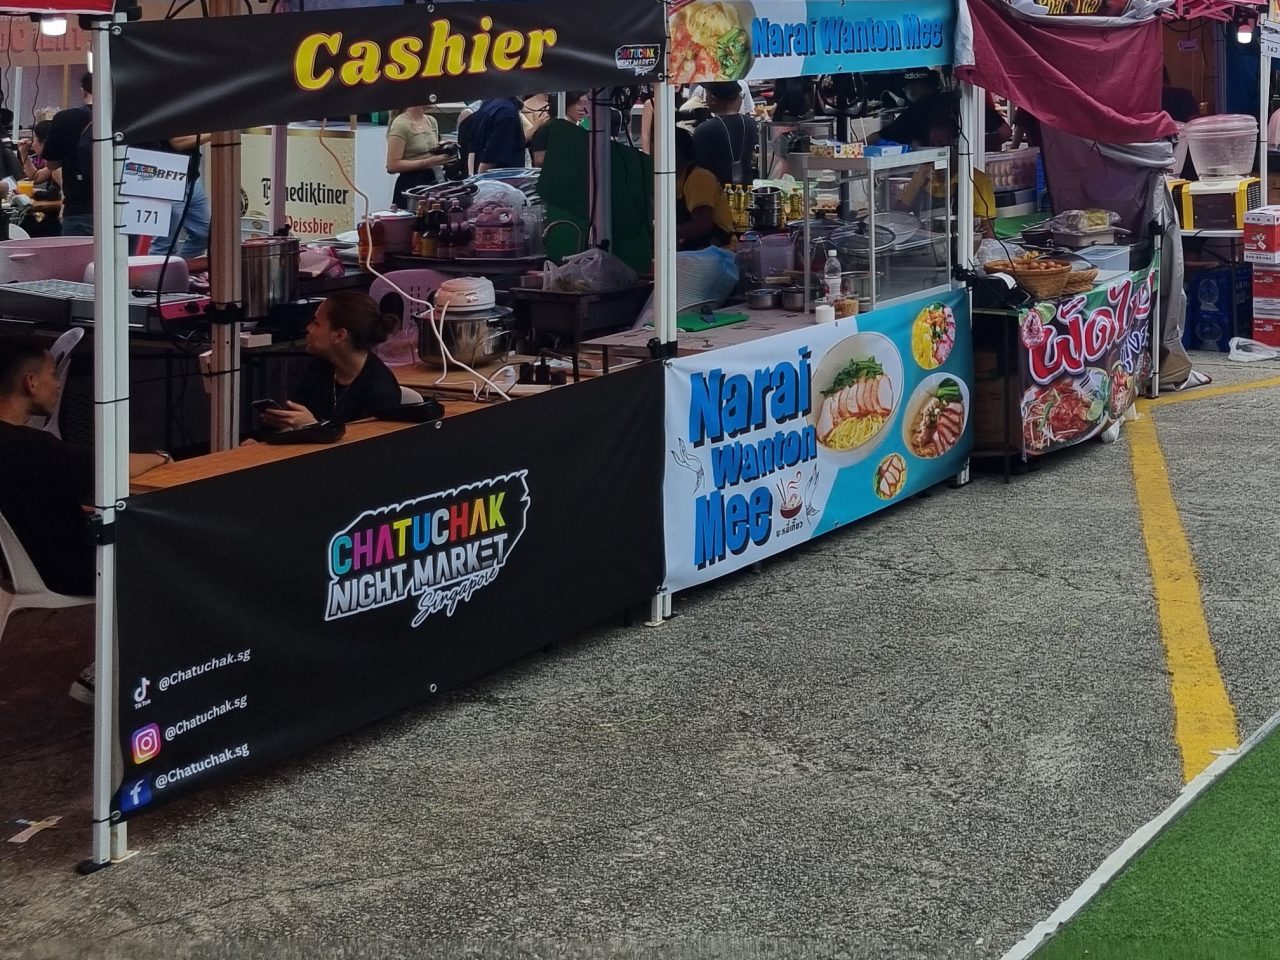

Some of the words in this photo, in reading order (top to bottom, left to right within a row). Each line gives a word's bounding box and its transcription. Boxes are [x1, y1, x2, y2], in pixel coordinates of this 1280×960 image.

[295, 16, 557, 90] Cashier
[752, 17, 817, 58] Narai
[820, 16, 901, 54] Wanton
[902, 14, 945, 49] Mee
[1267, 45, 1278, 53] 163
[136, 209, 159, 224] 171
[689, 345, 812, 448] Narai
[711, 424, 818, 490] Wanton
[332, 491, 506, 575] CHATUCHAK
[694, 486, 773, 571] Mee
[330, 563, 408, 616] NIGHT
[413, 532, 509, 590] MARKET
[158, 648, 251, 692] @Chatuchak.sg
[164, 694, 248, 741] @Chatuchak.sg
[155, 742, 250, 790] @Chatuchak.sg
